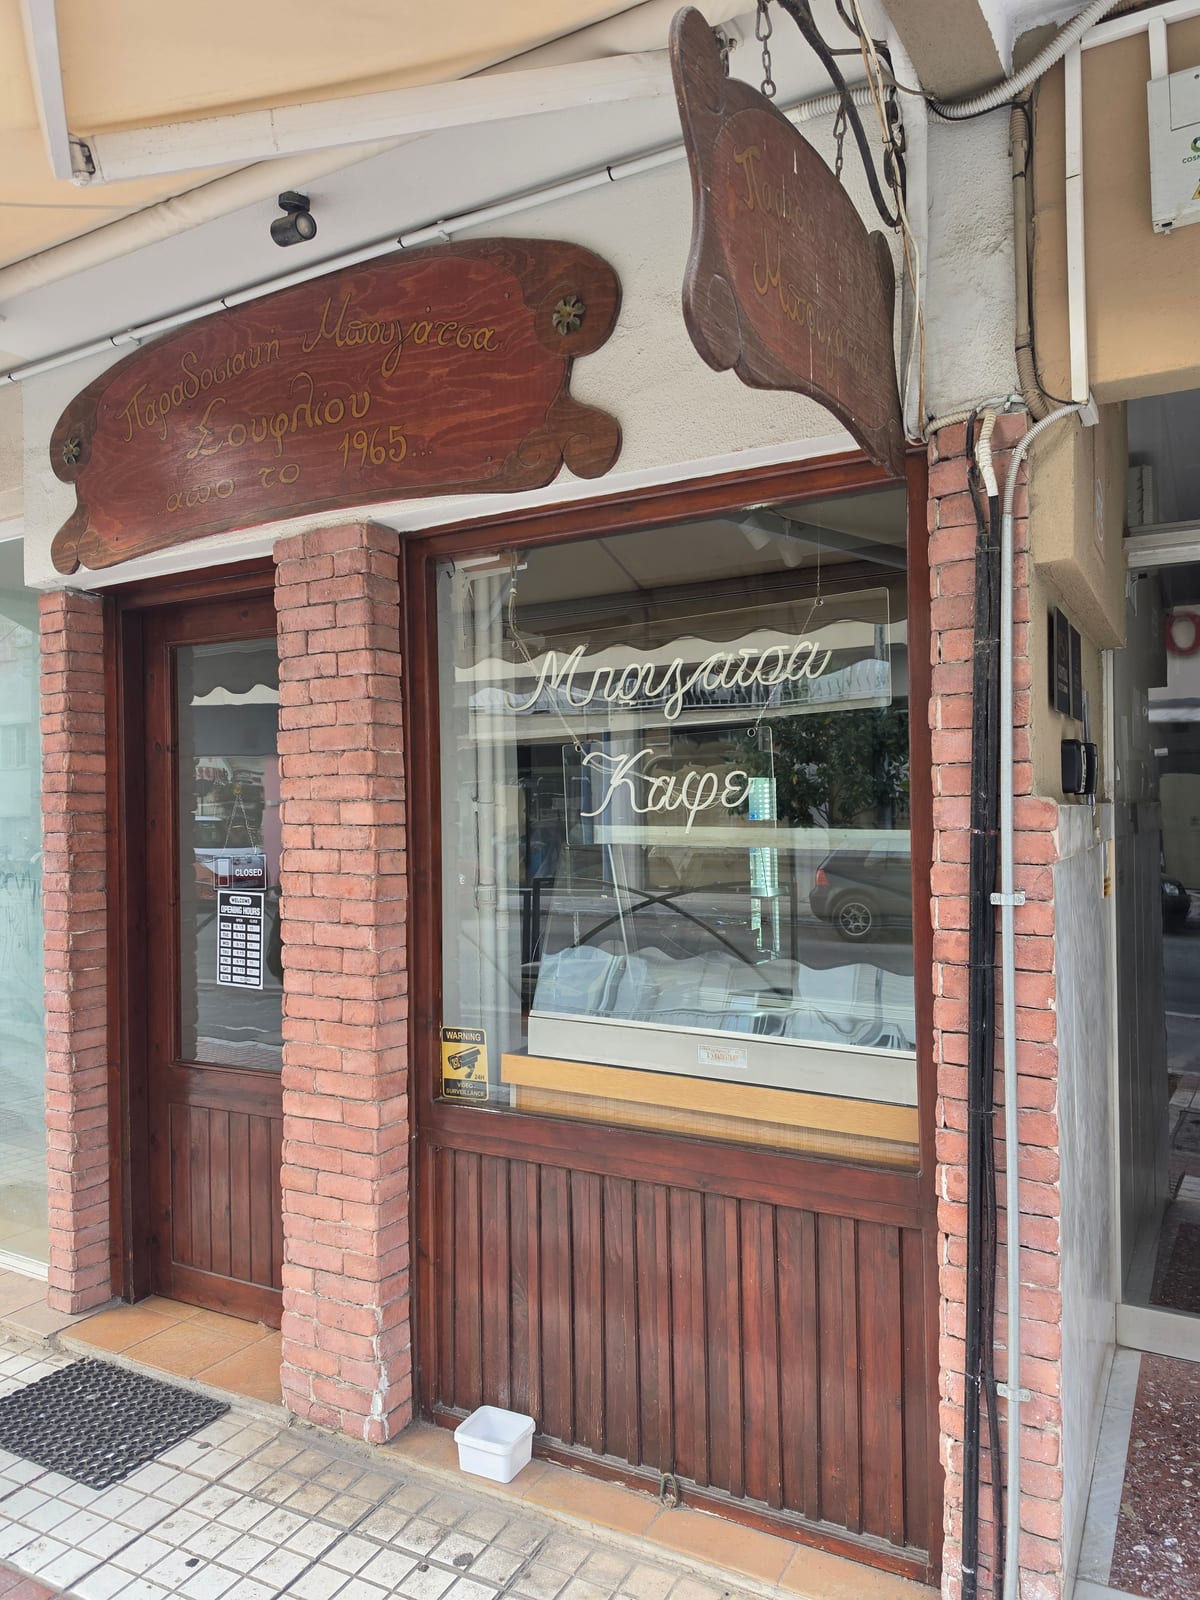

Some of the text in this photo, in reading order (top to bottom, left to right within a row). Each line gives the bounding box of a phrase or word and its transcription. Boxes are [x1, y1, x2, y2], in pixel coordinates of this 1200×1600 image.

[257, 463, 302, 490] το
[235, 868, 263, 877] CLOSED
[446, 1031, 481, 1041] WARNING
[446, 1088, 485, 1097] SURVEILLANCE
